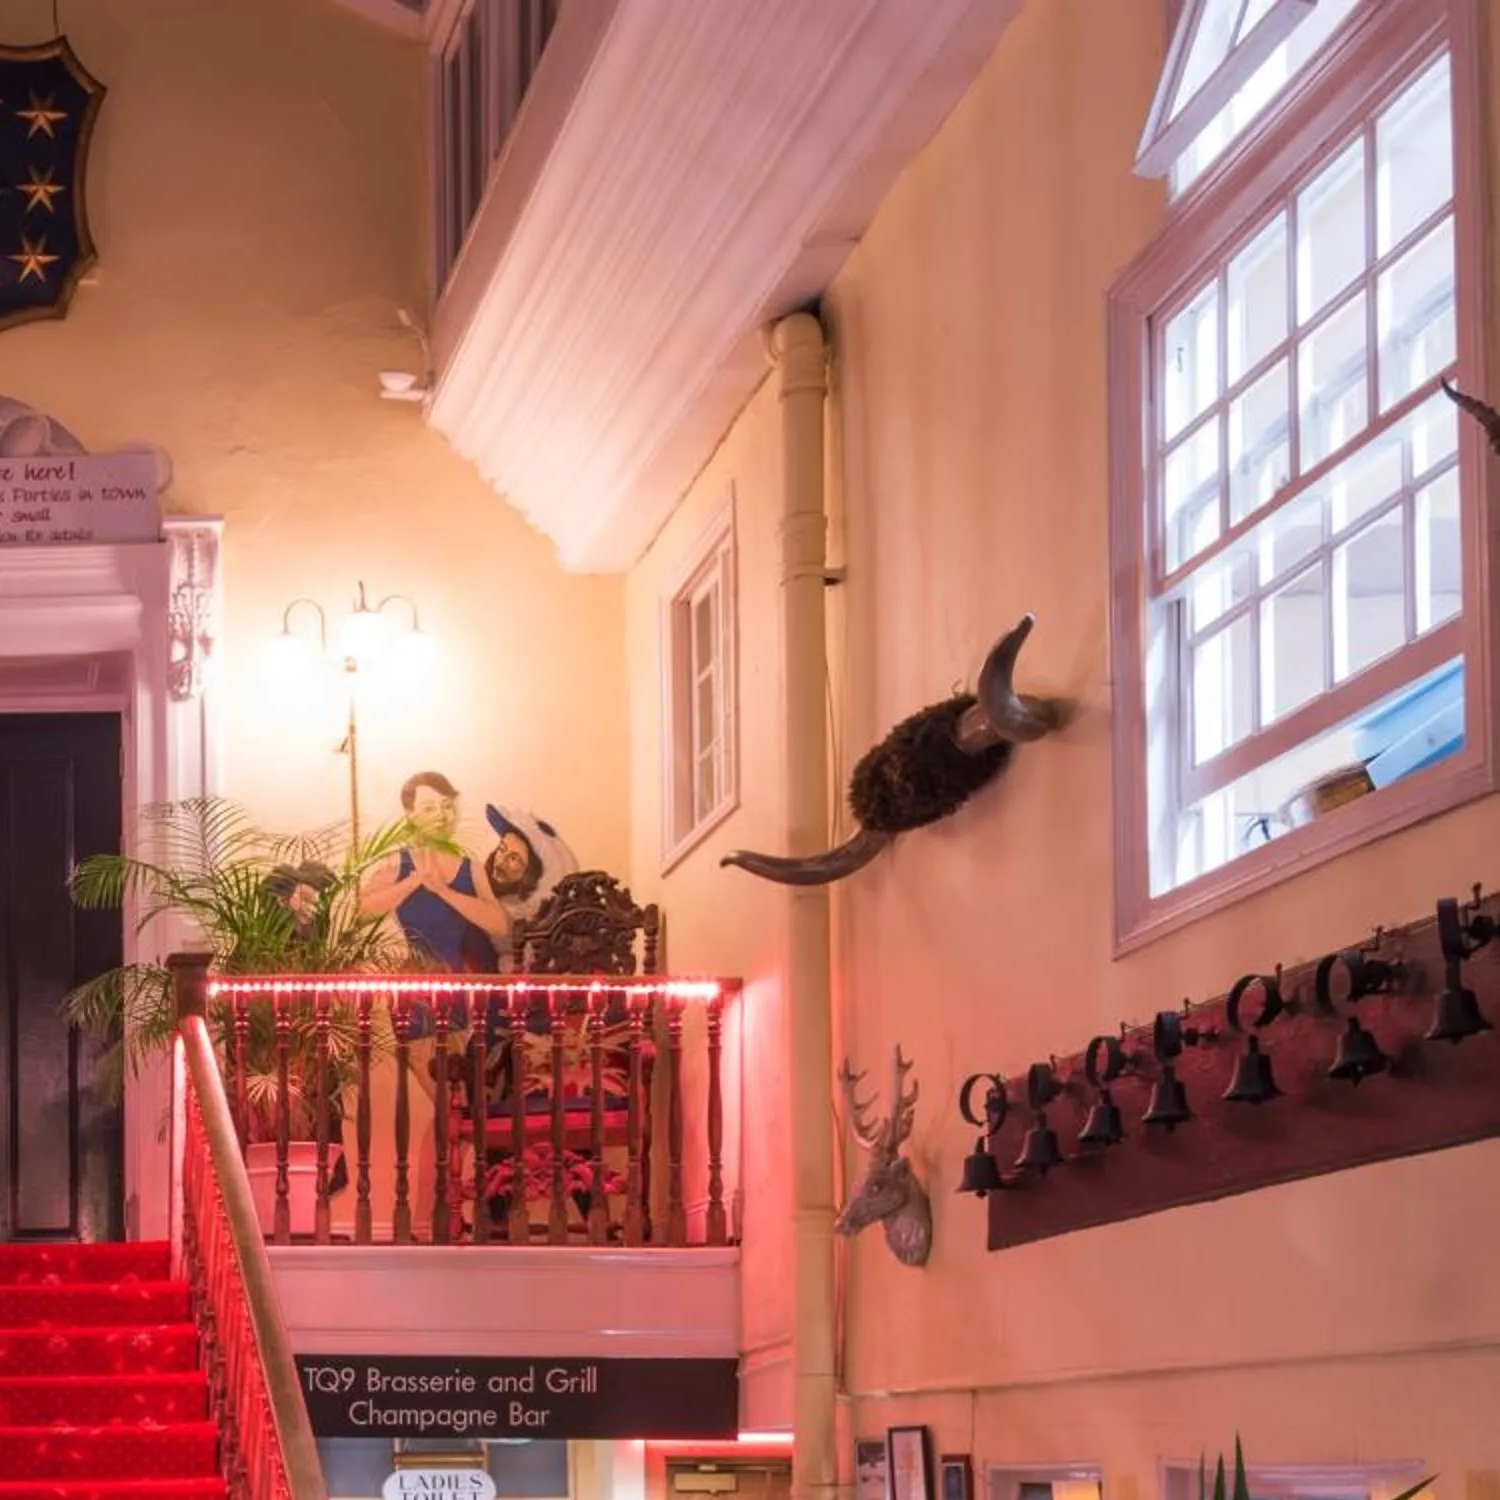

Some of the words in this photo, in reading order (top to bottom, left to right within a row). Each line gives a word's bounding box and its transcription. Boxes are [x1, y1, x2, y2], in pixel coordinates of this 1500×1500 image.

[24, 461, 75, 481] here!
[12, 487, 71, 503] Parties
[101, 486, 146, 501] town
[11, 507, 51, 523] small
[304, 1367, 356, 1394] TQ9
[367, 1369, 476, 1393] Brasserie
[487, 1369, 535, 1393] and
[545, 1368, 597, 1393] Grill
[349, 1401, 498, 1431] Champagne
[509, 1402, 550, 1426] Bar
[399, 1474, 484, 1490] LADIES
